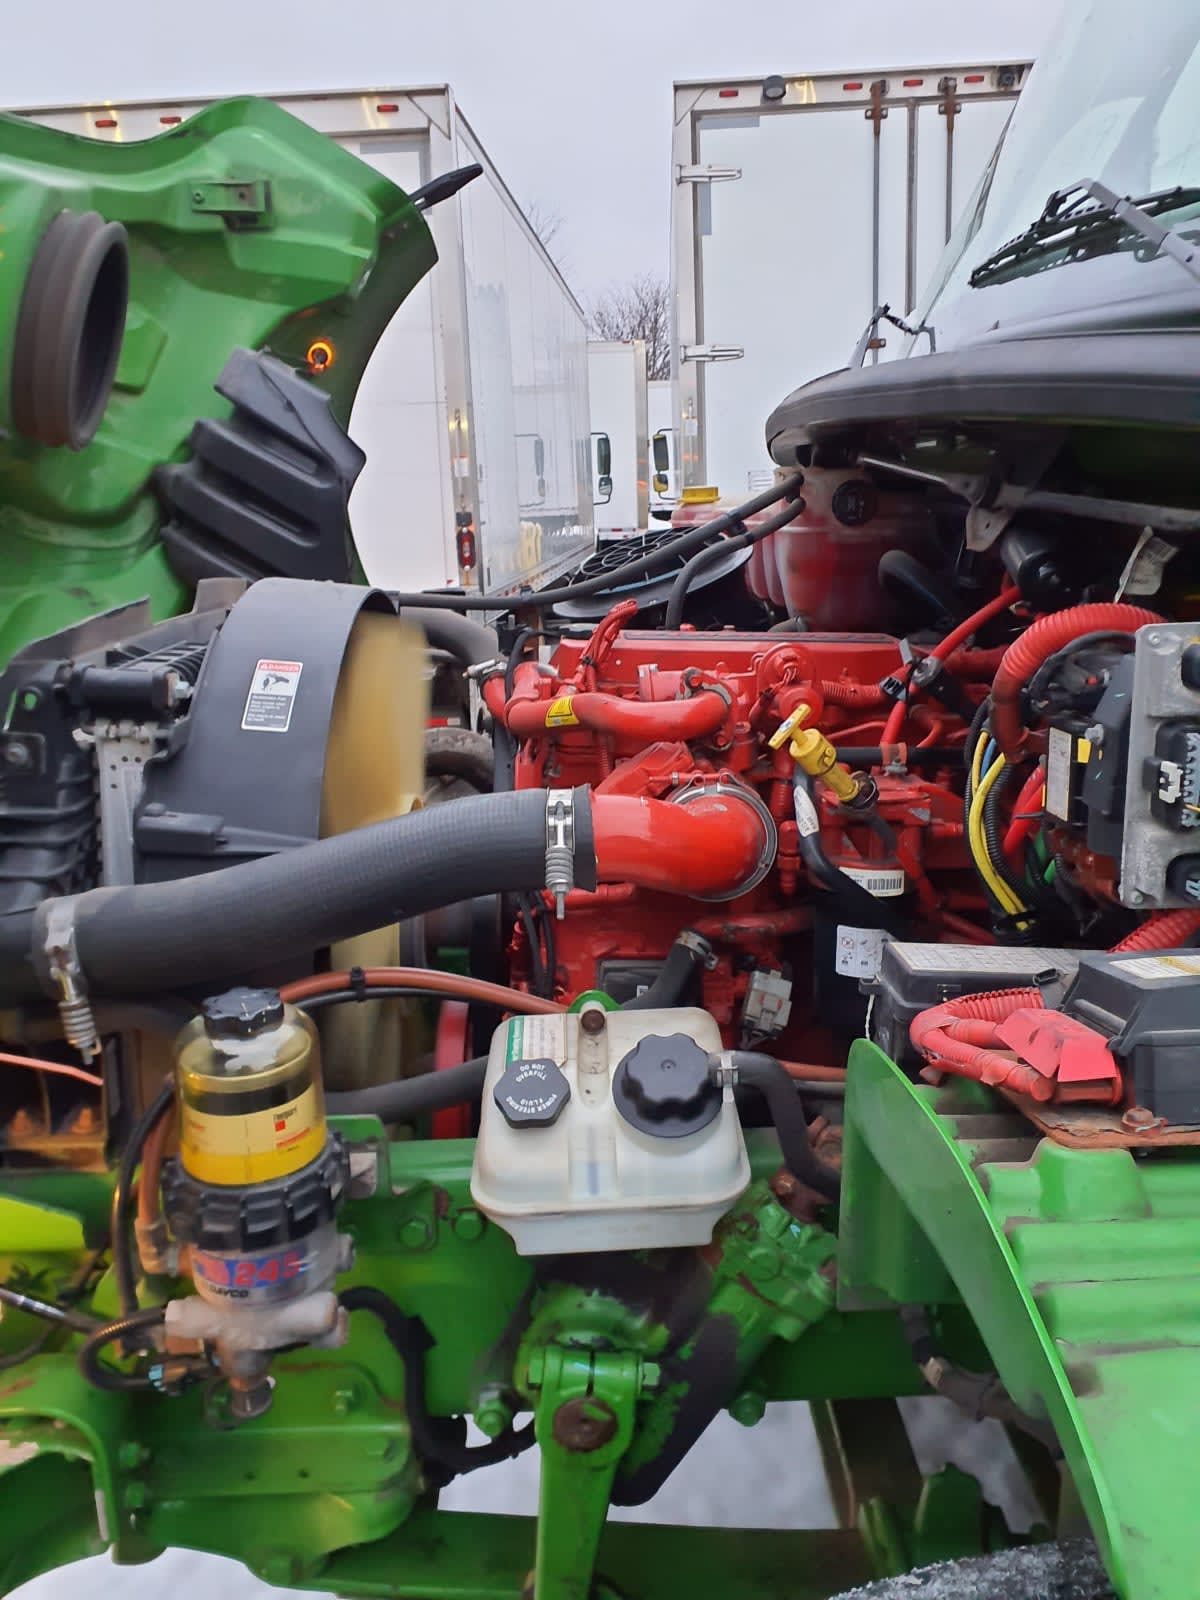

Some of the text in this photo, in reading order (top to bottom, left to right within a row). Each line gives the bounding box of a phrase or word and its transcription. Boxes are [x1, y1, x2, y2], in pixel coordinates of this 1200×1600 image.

[520, 1063, 545, 1072] DO NOT
[515, 1070, 547, 1083] OVERFILL
[506, 1093, 558, 1114] POWER STEERING
[520, 1097, 543, 1106] FLUID
[235, 1251, 300, 1287] 245
